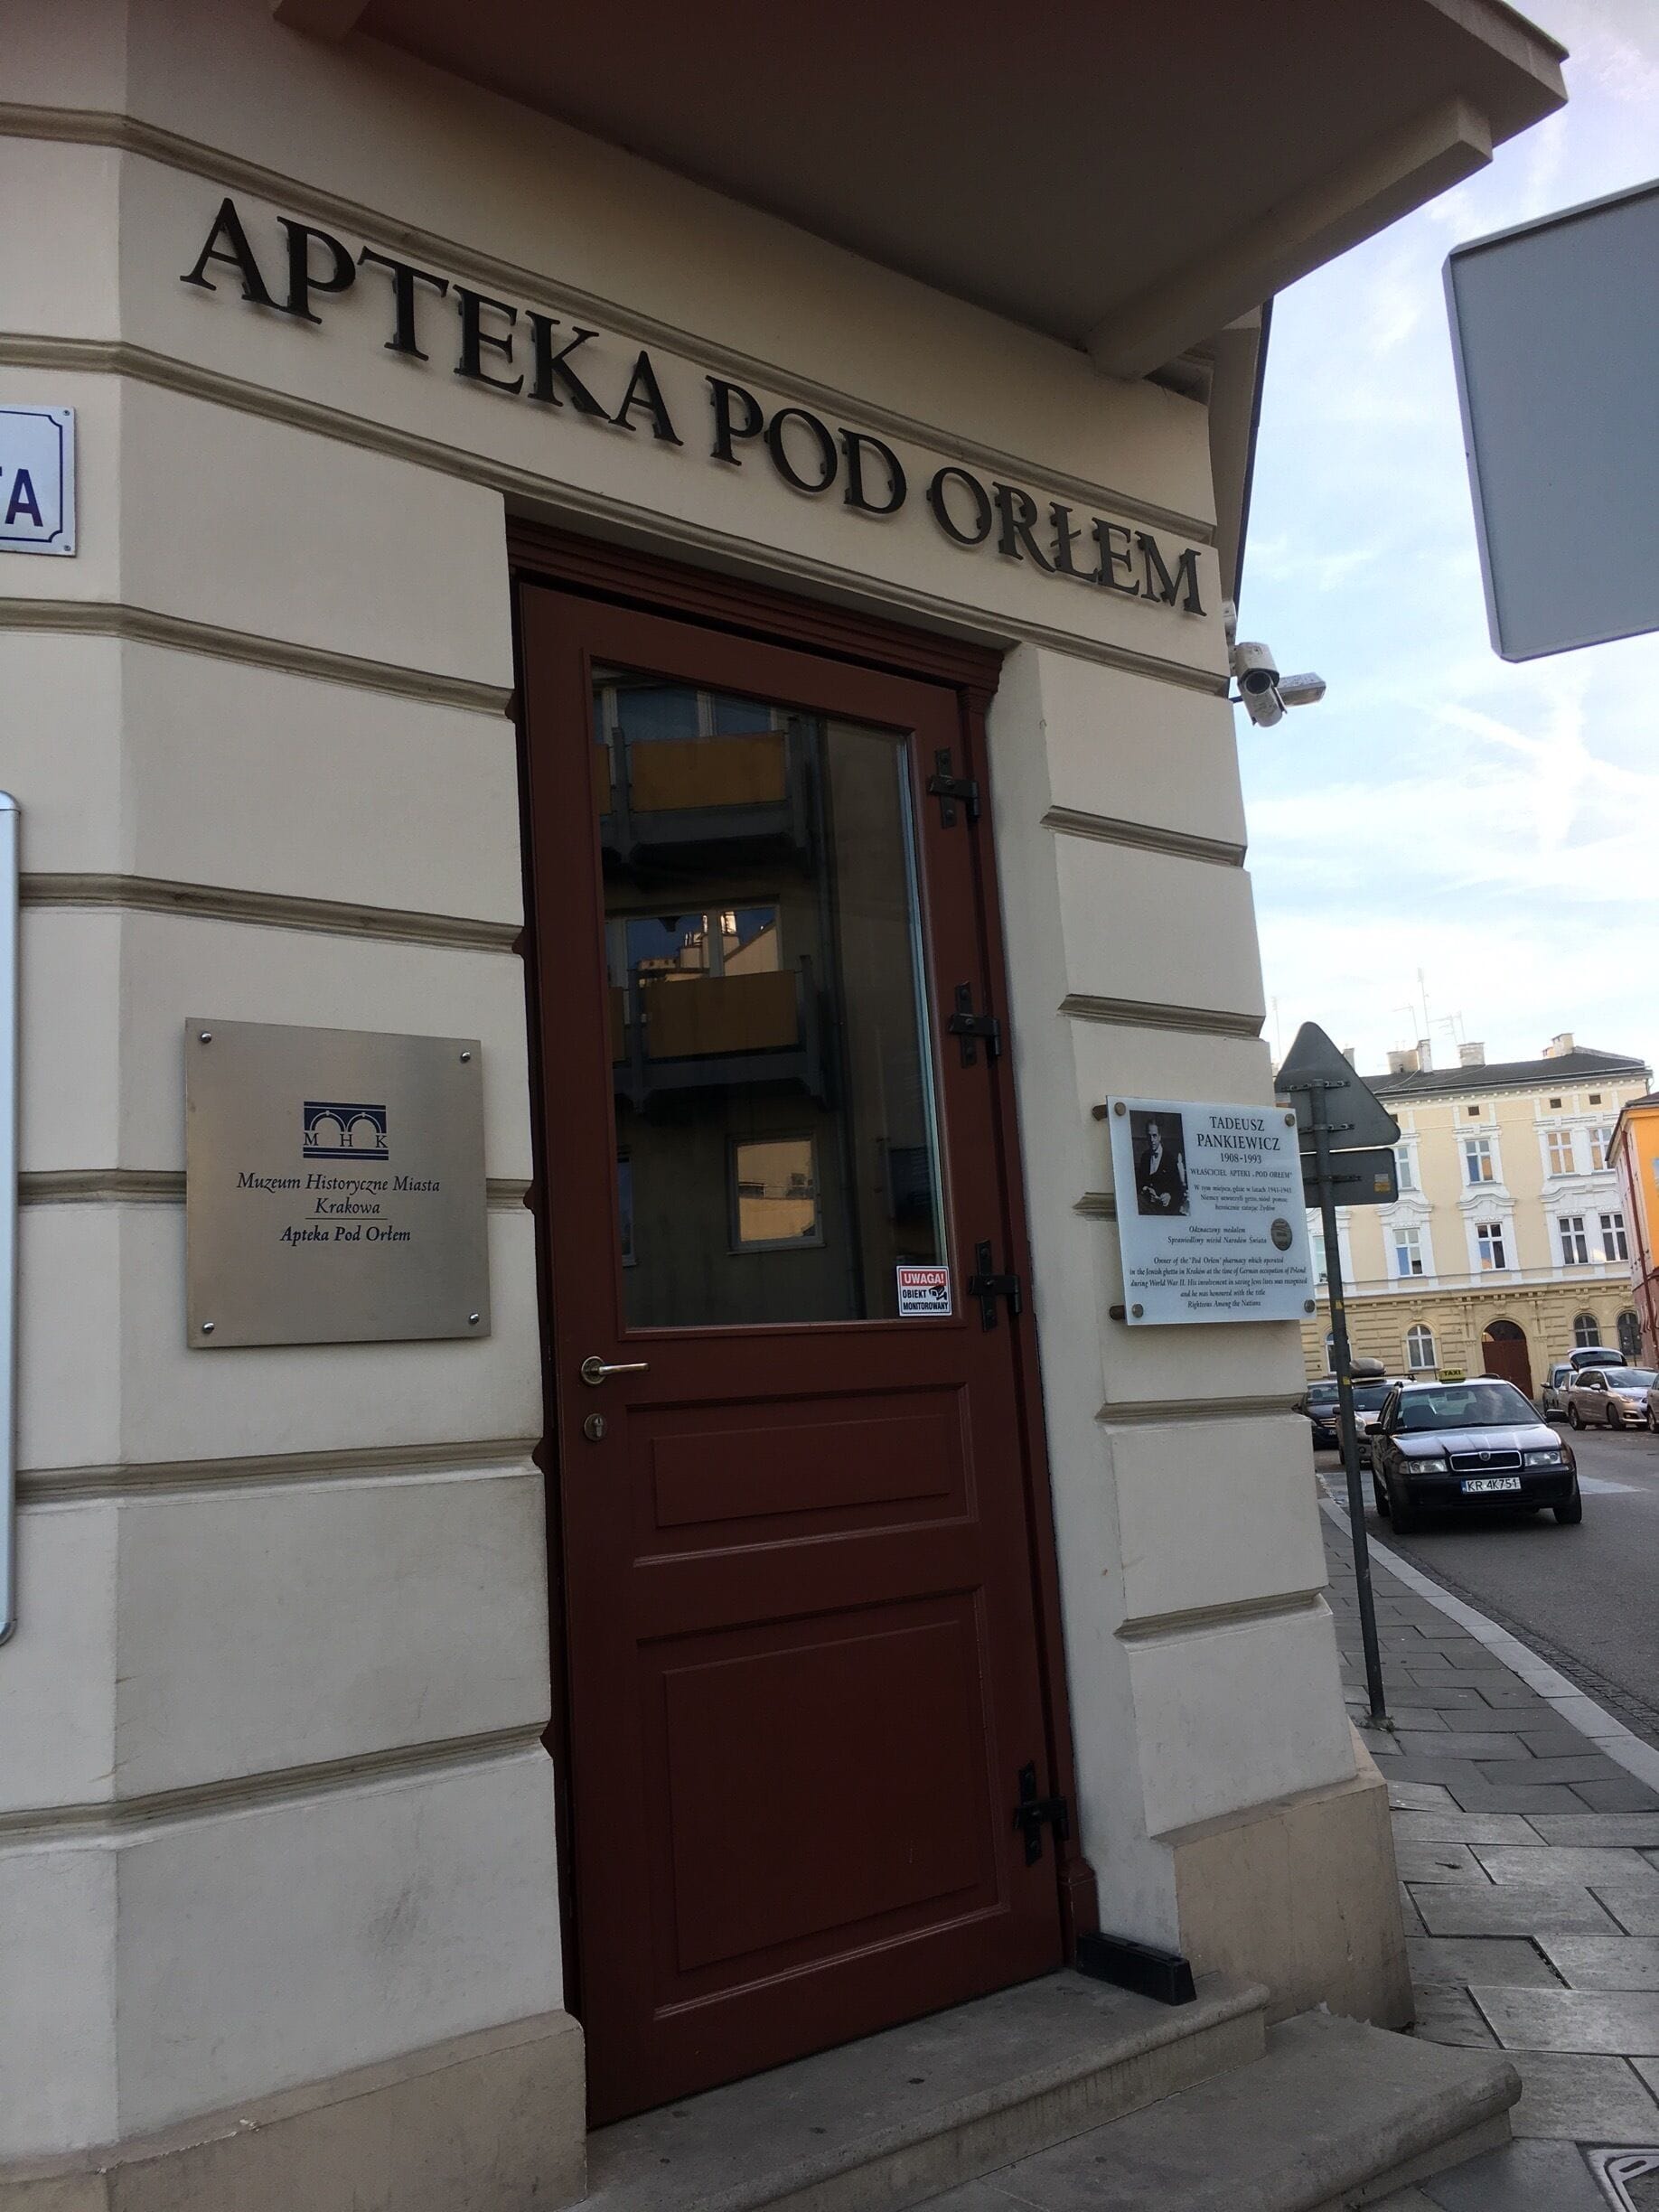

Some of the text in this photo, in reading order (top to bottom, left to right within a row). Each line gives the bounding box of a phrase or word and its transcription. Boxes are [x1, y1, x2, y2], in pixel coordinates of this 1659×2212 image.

[180, 197, 1206, 617] APTEKA POD ORŁEM
[1210, 1116, 1265, 1131] TADEUSZ
[1196, 1133, 1280, 1151] PANKIEWICZ
[1221, 1153, 1262, 1164] 1908-1993
[236, 1172, 440, 1195] Muzeum Historyczne Miasta
[314, 1196, 380, 1214] Krakowa
[279, 1225, 411, 1247] Apteka Pod Orłem
[904, 1273, 944, 1284] UWAGA!
[903, 1289, 927, 1298] OBIEKT
[904, 1301, 949, 1310] MONITOROWANY
[1467, 1478, 1517, 1492] KR 4K751
